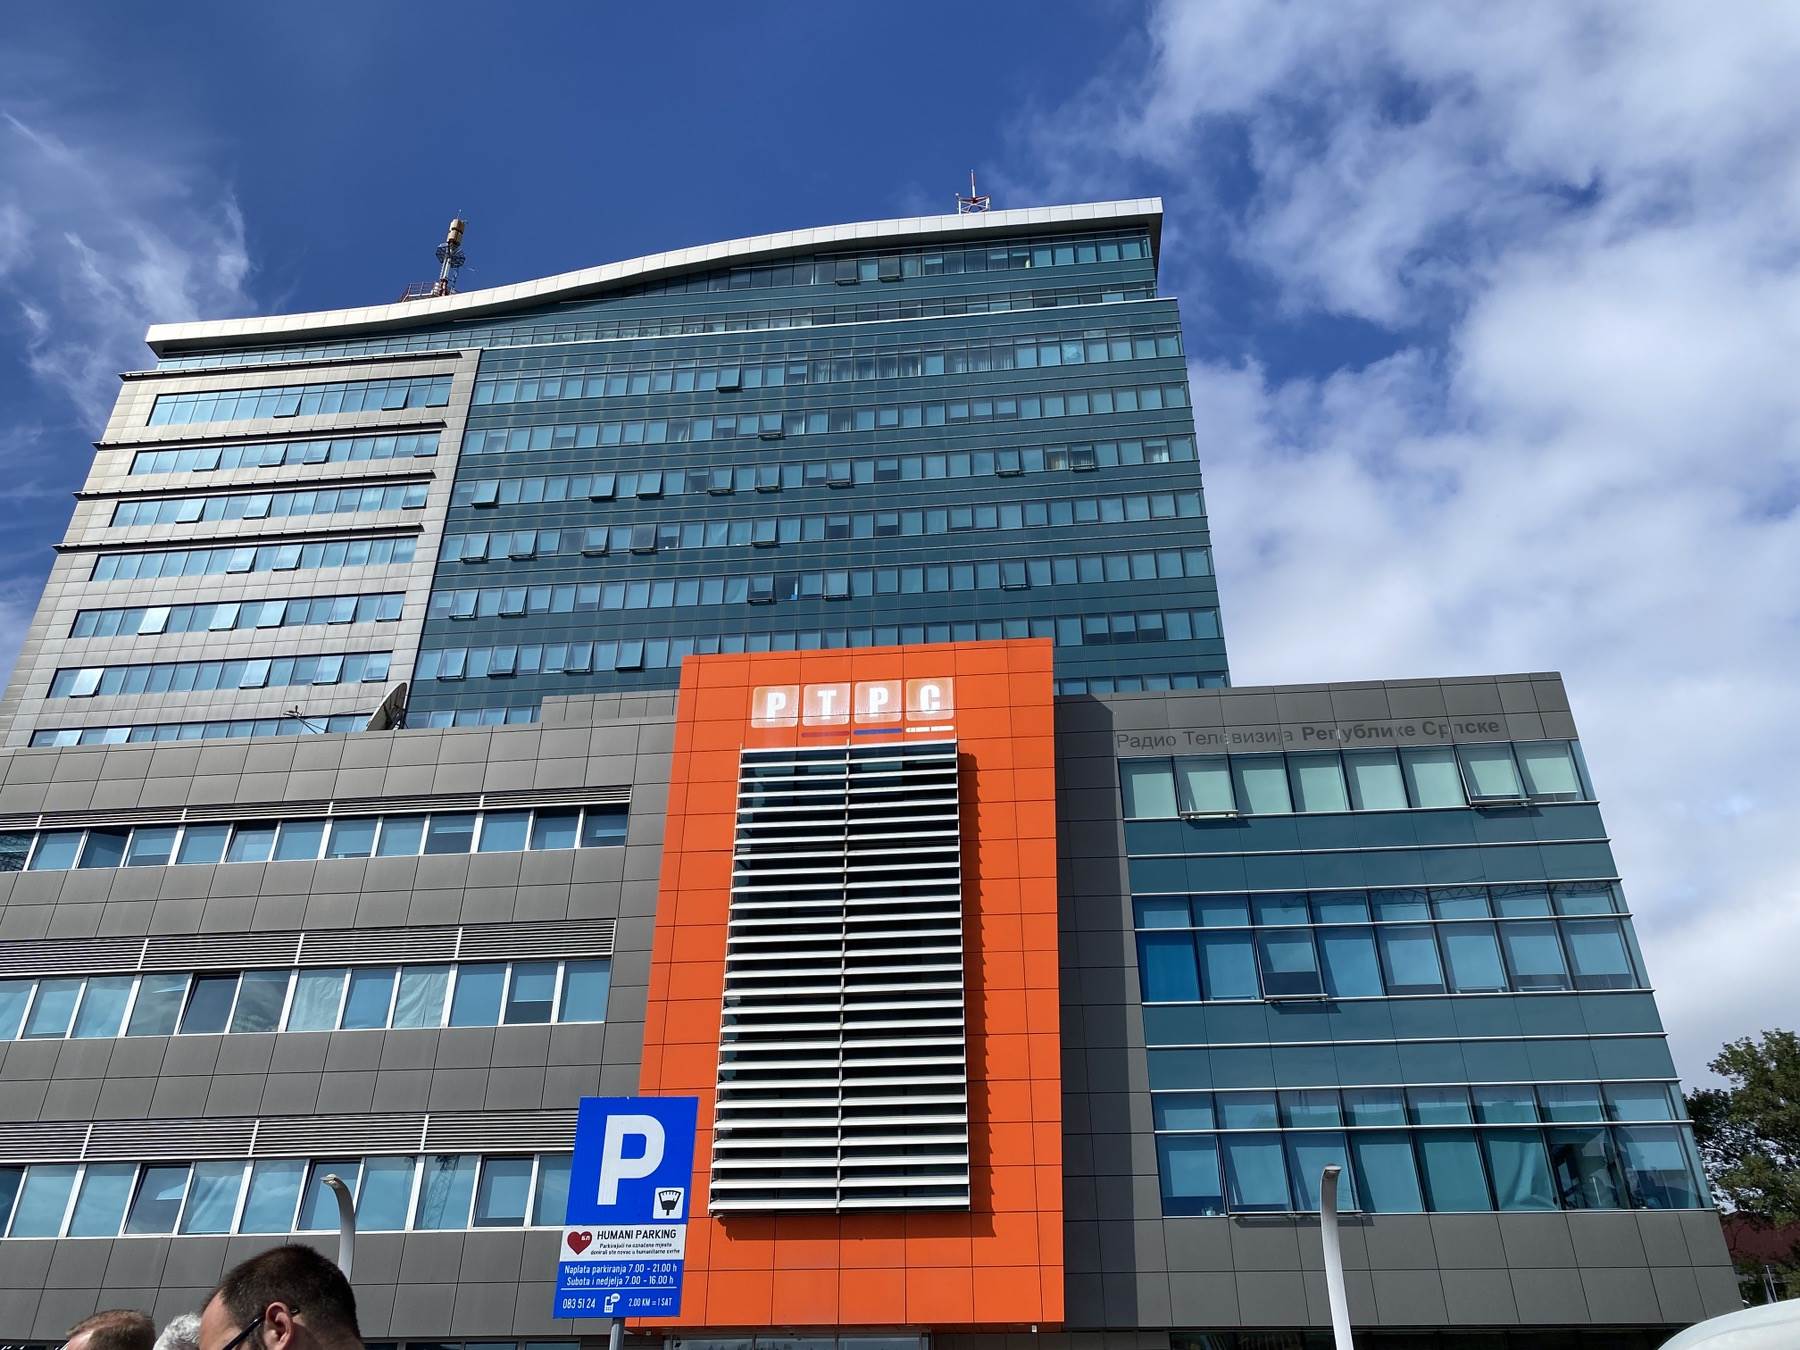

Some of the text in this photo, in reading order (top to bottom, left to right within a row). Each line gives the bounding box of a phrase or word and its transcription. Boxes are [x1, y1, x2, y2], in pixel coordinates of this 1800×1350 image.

[1117, 734, 1177, 750] Радио
[1302, 723, 1416, 743] Републике
[1422, 720, 1500, 739] Српске
[597, 1114, 666, 1206] P
[597, 1229, 677, 1240] HUMANI PARKING
[564, 1265, 591, 1276] Naplata
[592, 1264, 627, 1276] parkiranja
[628, 1263, 645, 1273] 7.00
[652, 1263, 671, 1273] 21.00
[672, 1263, 678, 1272] h
[566, 1277, 591, 1286] Subota
[595, 1276, 623, 1287] nedjelja
[624, 1275, 641, 1285] 7.00
[648, 1275, 668, 1285] 16.00
[668, 1275, 674, 1285] h
[628, 1298, 641, 1307] 2.00
[641, 1297, 651, 1307] KM
[661, 1297, 673, 1306] SAT
